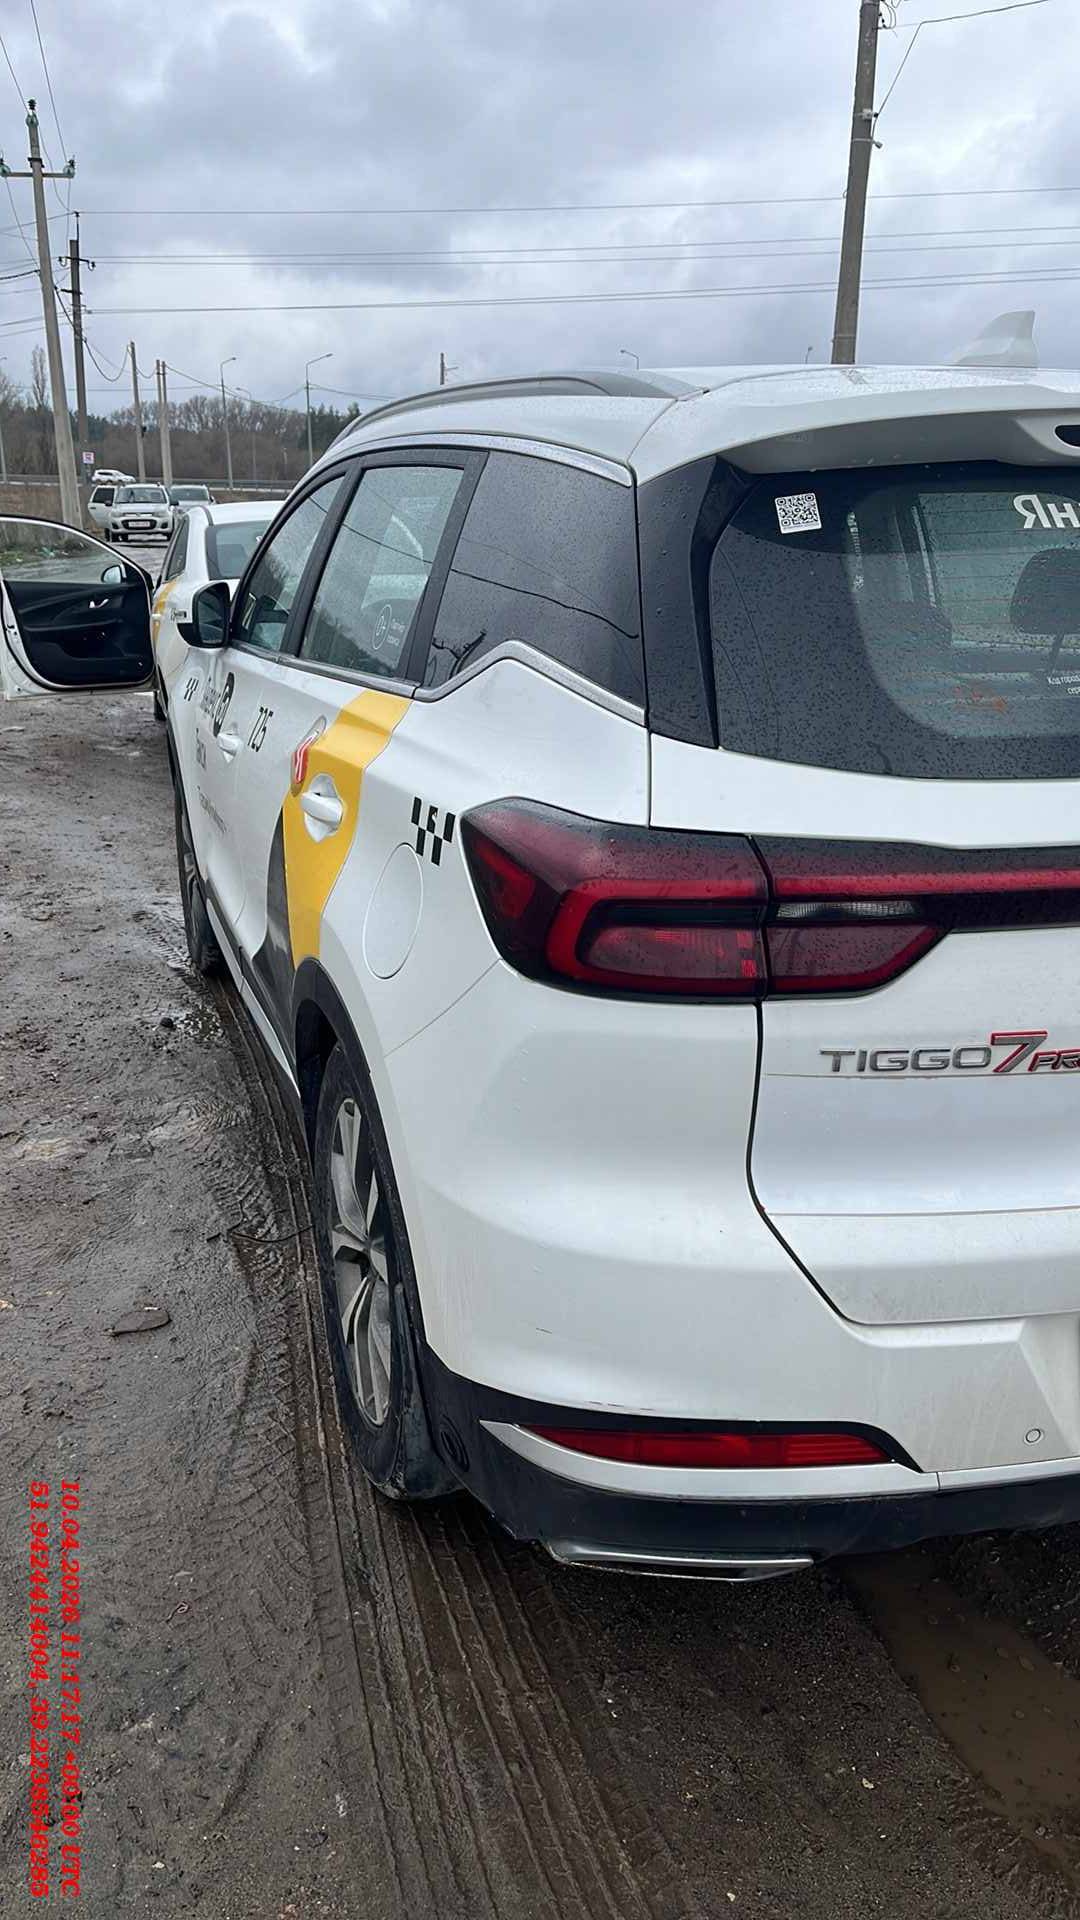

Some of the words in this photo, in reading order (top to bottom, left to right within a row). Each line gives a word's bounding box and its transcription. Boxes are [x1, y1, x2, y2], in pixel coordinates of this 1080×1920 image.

[1013, 494, 1080, 529] Ян
[247, 706, 274, 752] 725
[819, 1046, 992, 1072] TIGGO
[990, 1030, 1048, 1072] 7
[1027, 1048, 1080, 1072] PR
